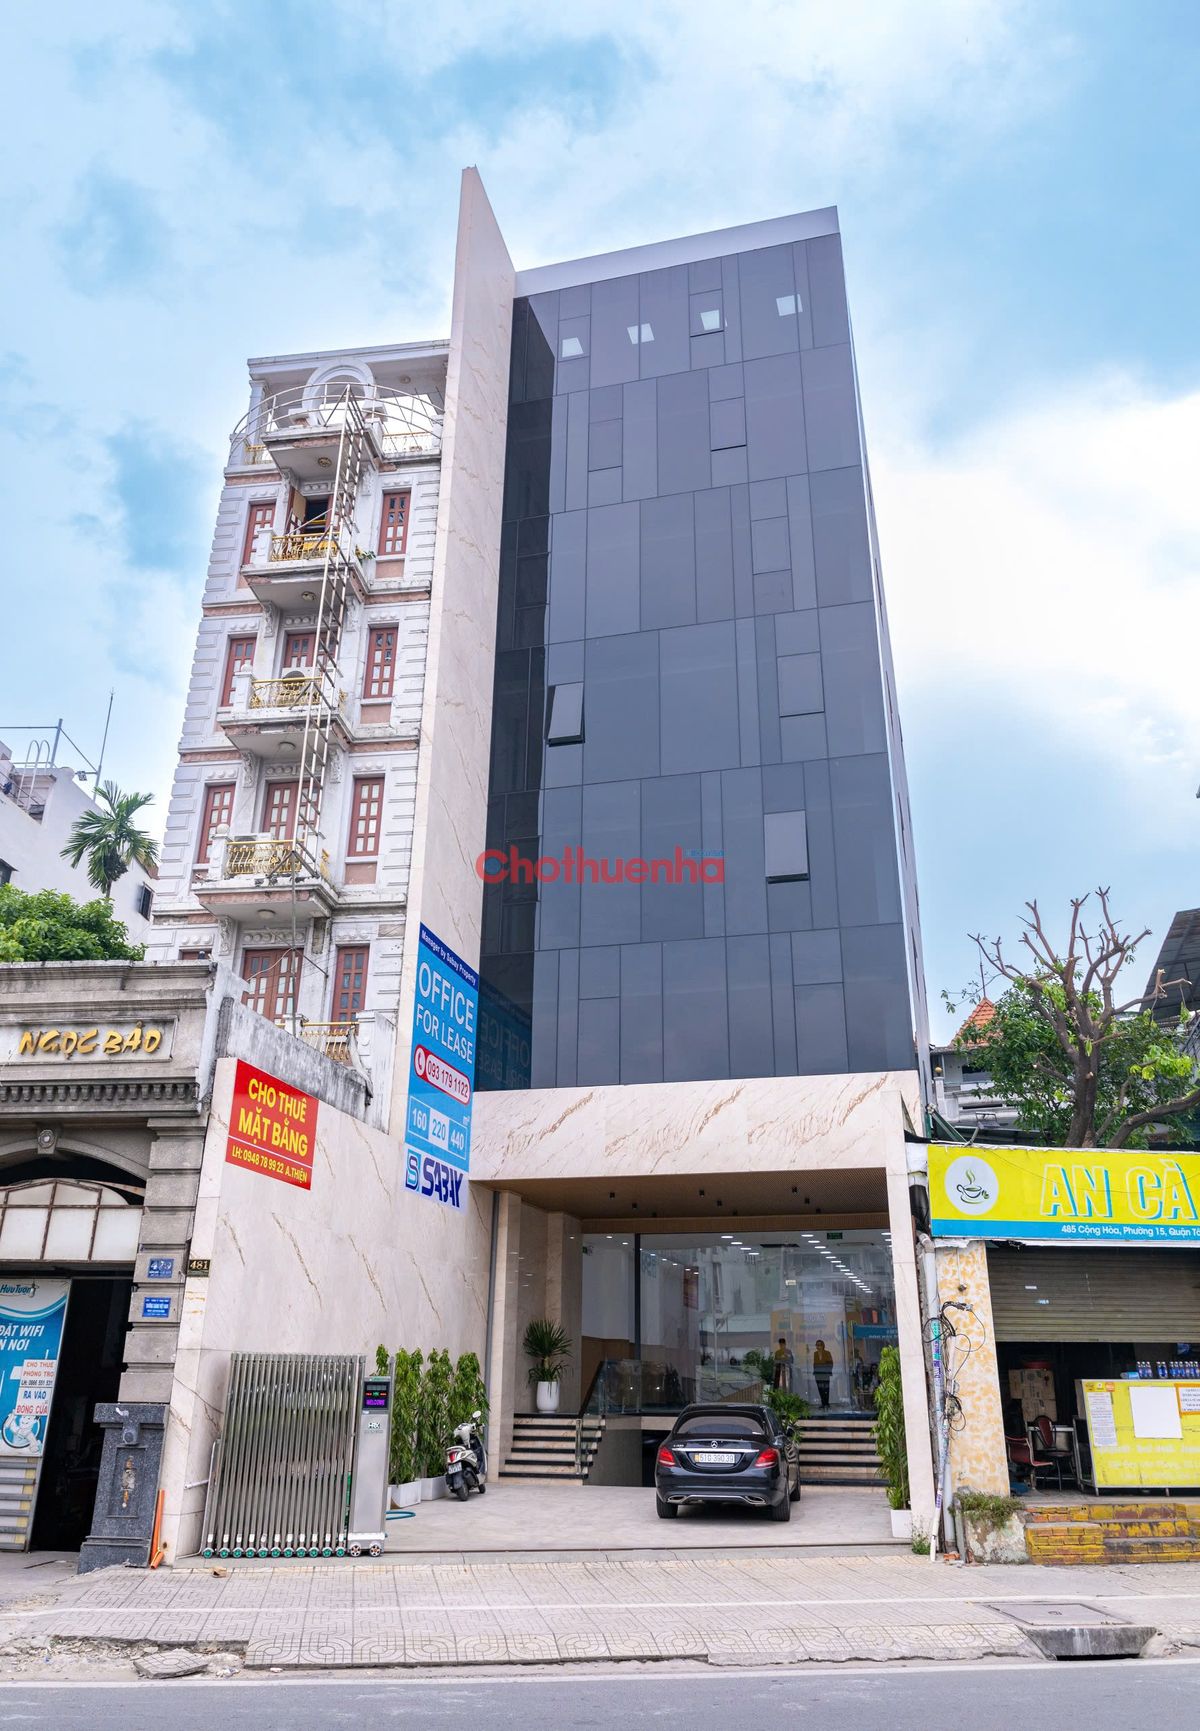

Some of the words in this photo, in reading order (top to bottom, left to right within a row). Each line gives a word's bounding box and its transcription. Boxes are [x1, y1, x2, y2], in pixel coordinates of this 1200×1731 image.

[421, 930, 440, 953] Manager
[440, 947, 446, 960] by
[446, 952, 459, 971] Sabay
[459, 964, 476, 986] Property
[418, 962, 474, 1033] OFFICE
[18, 1029, 99, 1060] NGỌC
[103, 1020, 162, 1054] BẢO
[416, 1003, 439, 1041] FOR
[441, 1022, 473, 1065] LEASE
[428, 1060, 440, 1080] 093
[441, 1069, 453, 1088] 179
[454, 1077, 469, 1098] 1122
[248, 1078, 277, 1108] CHO
[278, 1091, 308, 1123] THUÊ
[239, 1106, 271, 1144] MẶT
[271, 1117, 308, 1157] BẰNG
[412, 1107, 427, 1131] 160
[431, 1118, 446, 1141] 220
[450, 1129, 465, 1151] 440
[232, 1145, 242, 1159] LH:
[243, 1150, 260, 1166] 0948
[260, 1155, 268, 1168] 78
[268, 1159, 276, 1171] 99
[276, 1161, 284, 1174] 22
[421, 1157, 464, 1208] SABAY
[1040, 1163, 1113, 1217] AN
[1126, 1158, 1199, 1220] CÀ
[1061, 1225, 1077, 1233] 485
[1078, 1225, 1101, 1236] Cộng
[1102, 1226, 1122, 1236] Hòa,
[1123, 1226, 1154, 1237] Phường
[1155, 1227, 1168, 1236] 15,
[1168, 1227, 1191, 1238] Quận
[189, 1260, 209, 1270] 481
[8, 1338, 30, 1351] NƠI
[20, 1325, 45, 1337] WIFI
[23, 1390, 32, 1399] RA
